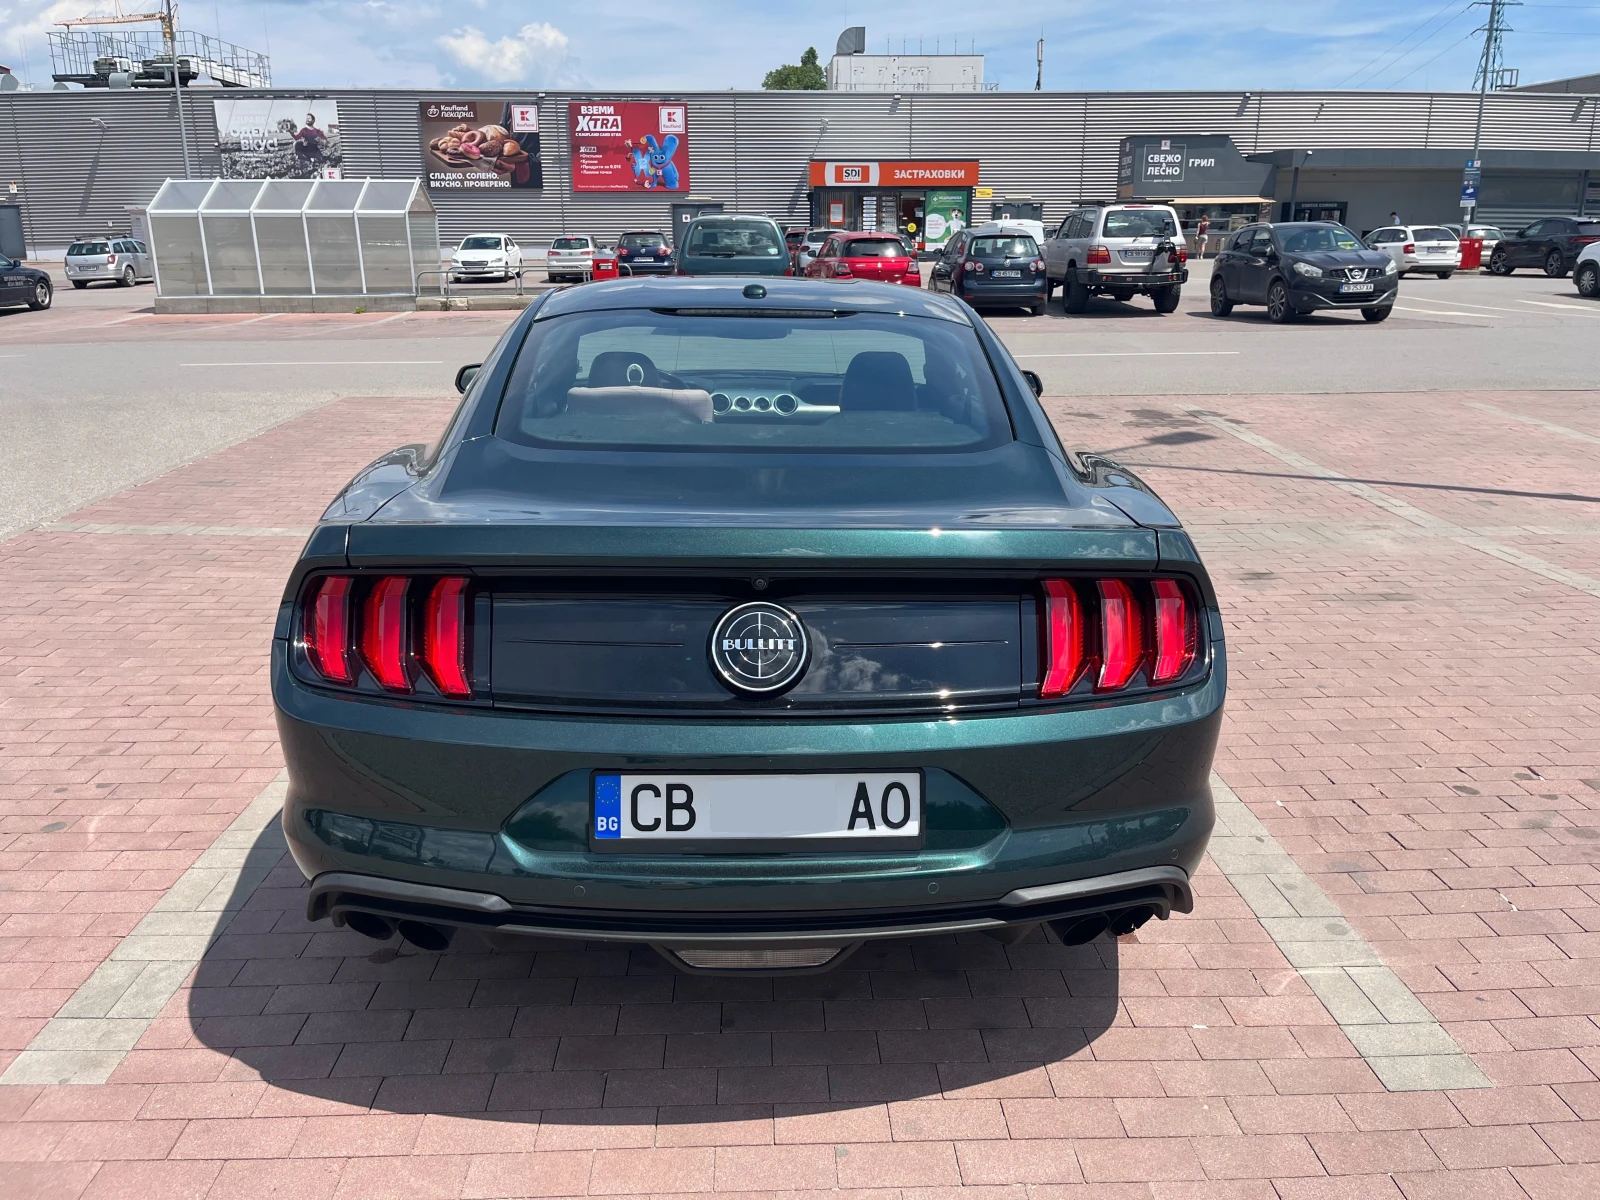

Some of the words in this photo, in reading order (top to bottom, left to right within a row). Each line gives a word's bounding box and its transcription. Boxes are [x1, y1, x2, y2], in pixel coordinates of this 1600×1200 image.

[580, 105, 614, 114] ВЗЕМИ
[441, 111, 474, 119] пекарна
[575, 115, 622, 131] XTRA
[240, 137, 279, 151] ВКУС!
[1147, 154, 1181, 163] СВЕЖО
[1188, 158, 1215, 167] ГРИЛ
[844, 168, 860, 177] SDI
[893, 169, 965, 179] ЗАСТРАХОВКИ
[1146, 166, 1180, 175] ЛЕСНО
[429, 172, 465, 181] СЛАДКО.
[466, 172, 500, 180] СОЛЕНО.
[430, 180, 463, 188] ВКУСНО.
[464, 180, 512, 188] ПРОВЕРЕНО.
[722, 638, 797, 651] BULLITT
[597, 816, 618, 831] BG
[630, 783, 696, 832] CB
[847, 781, 911, 831] AO
